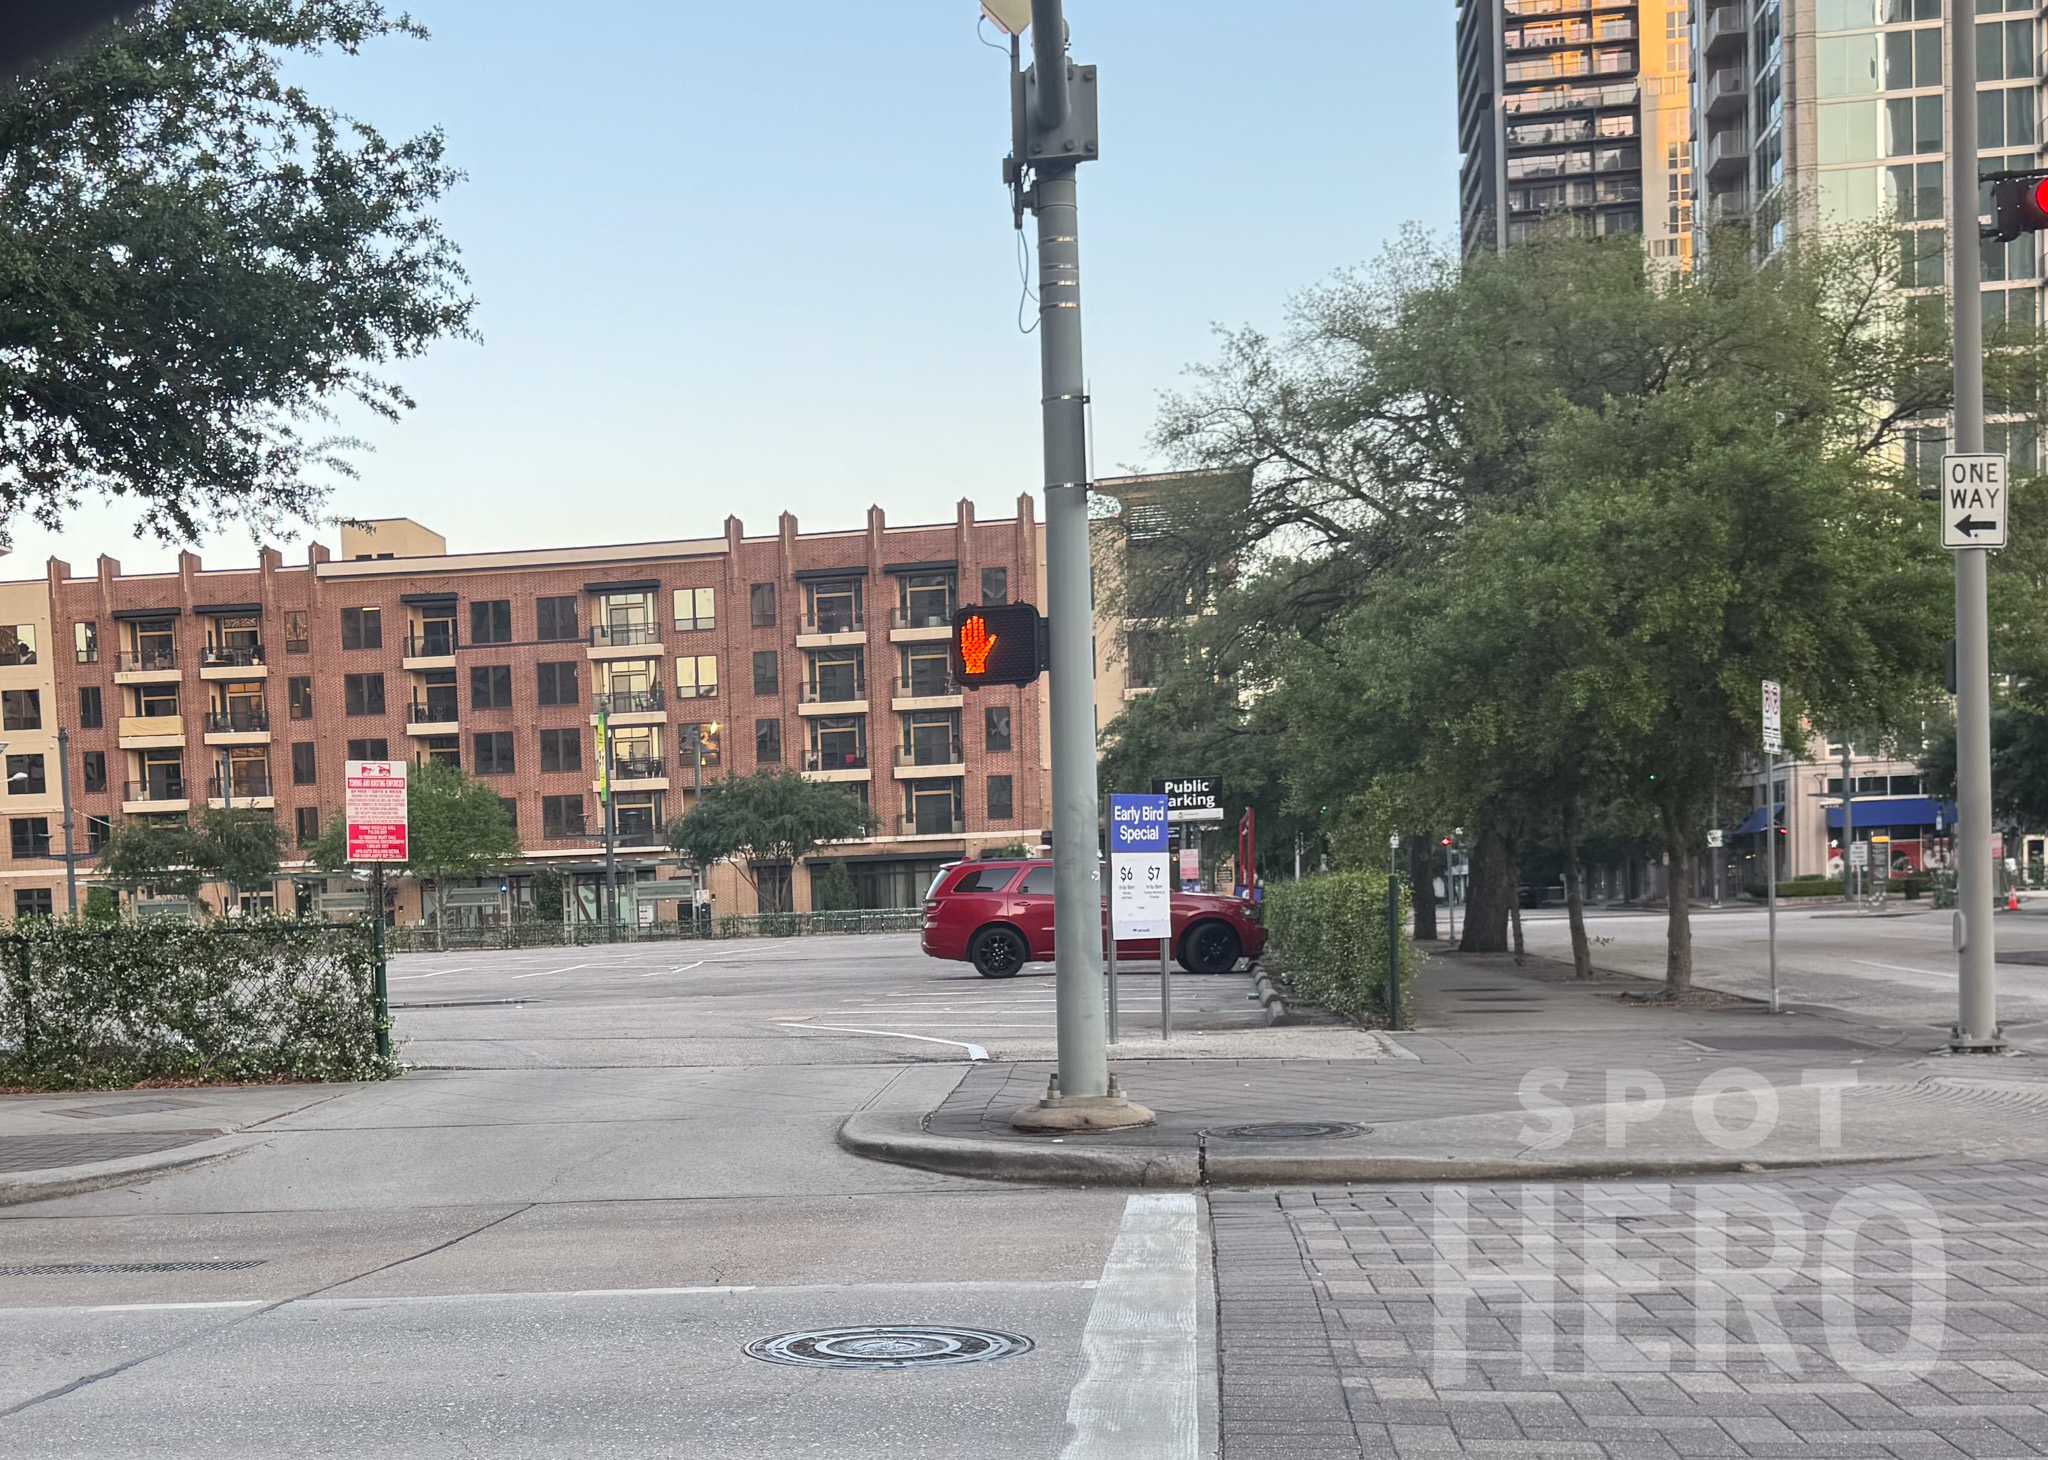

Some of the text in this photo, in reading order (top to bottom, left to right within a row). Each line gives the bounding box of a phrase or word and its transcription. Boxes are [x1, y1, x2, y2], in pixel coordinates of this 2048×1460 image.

[1952, 463, 1998, 483] ONE
[1951, 488, 1999, 509] WAY
[1165, 780, 1209, 794] Public
[1168, 794, 1215, 808] arking
[1115, 806, 1164, 823] Early Bird
[1120, 825, 1159, 843] Special
[1120, 866, 1160, 881] $6 $7
